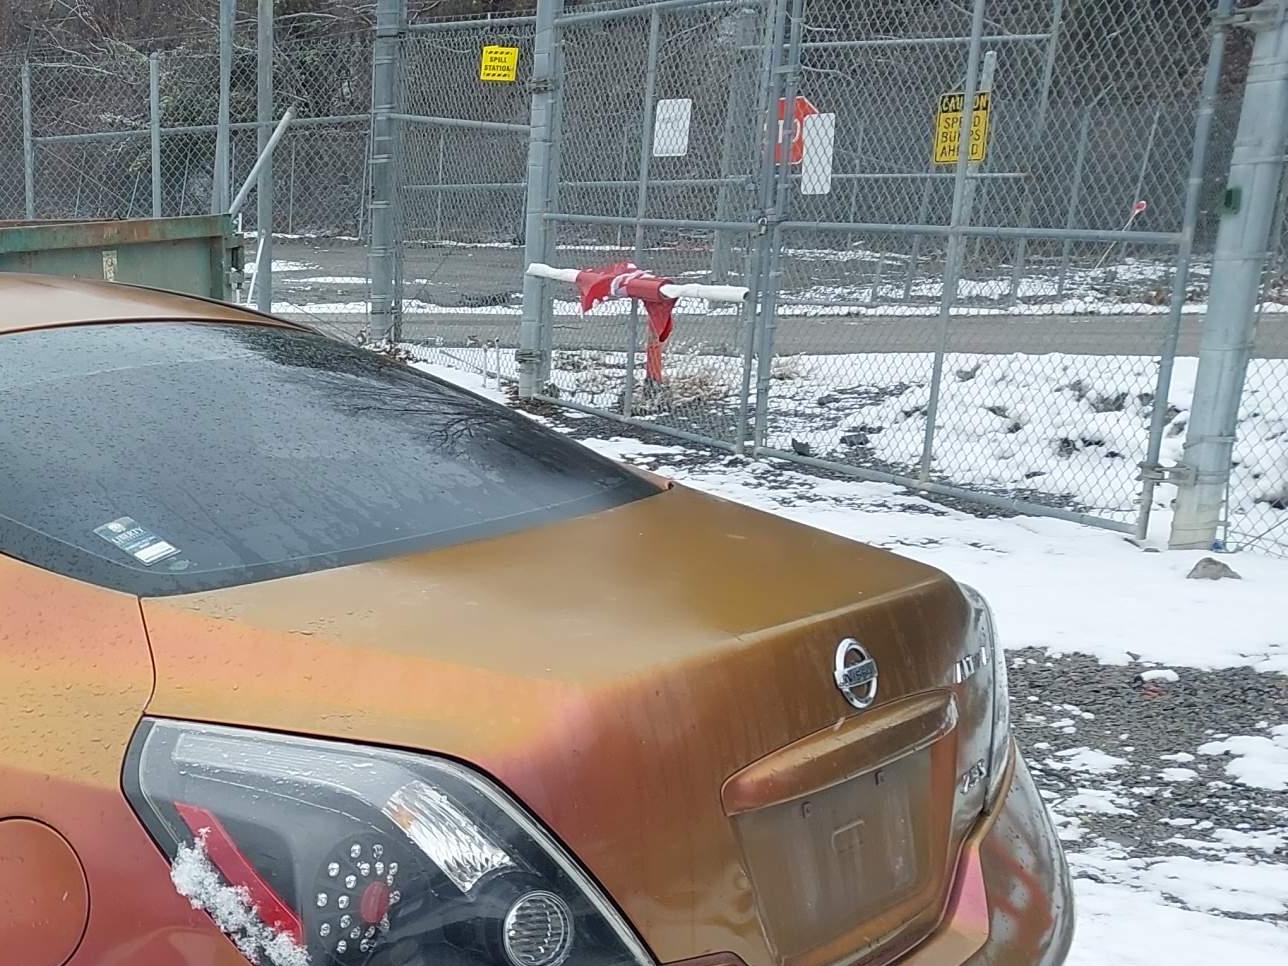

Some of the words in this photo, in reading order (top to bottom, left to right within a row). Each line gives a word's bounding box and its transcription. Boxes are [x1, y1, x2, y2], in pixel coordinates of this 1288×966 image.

[942, 94, 988, 112] CAUON
[944, 116, 981, 129] SPD
[942, 129, 981, 143] BUS
[940, 144, 978, 157] AHD
